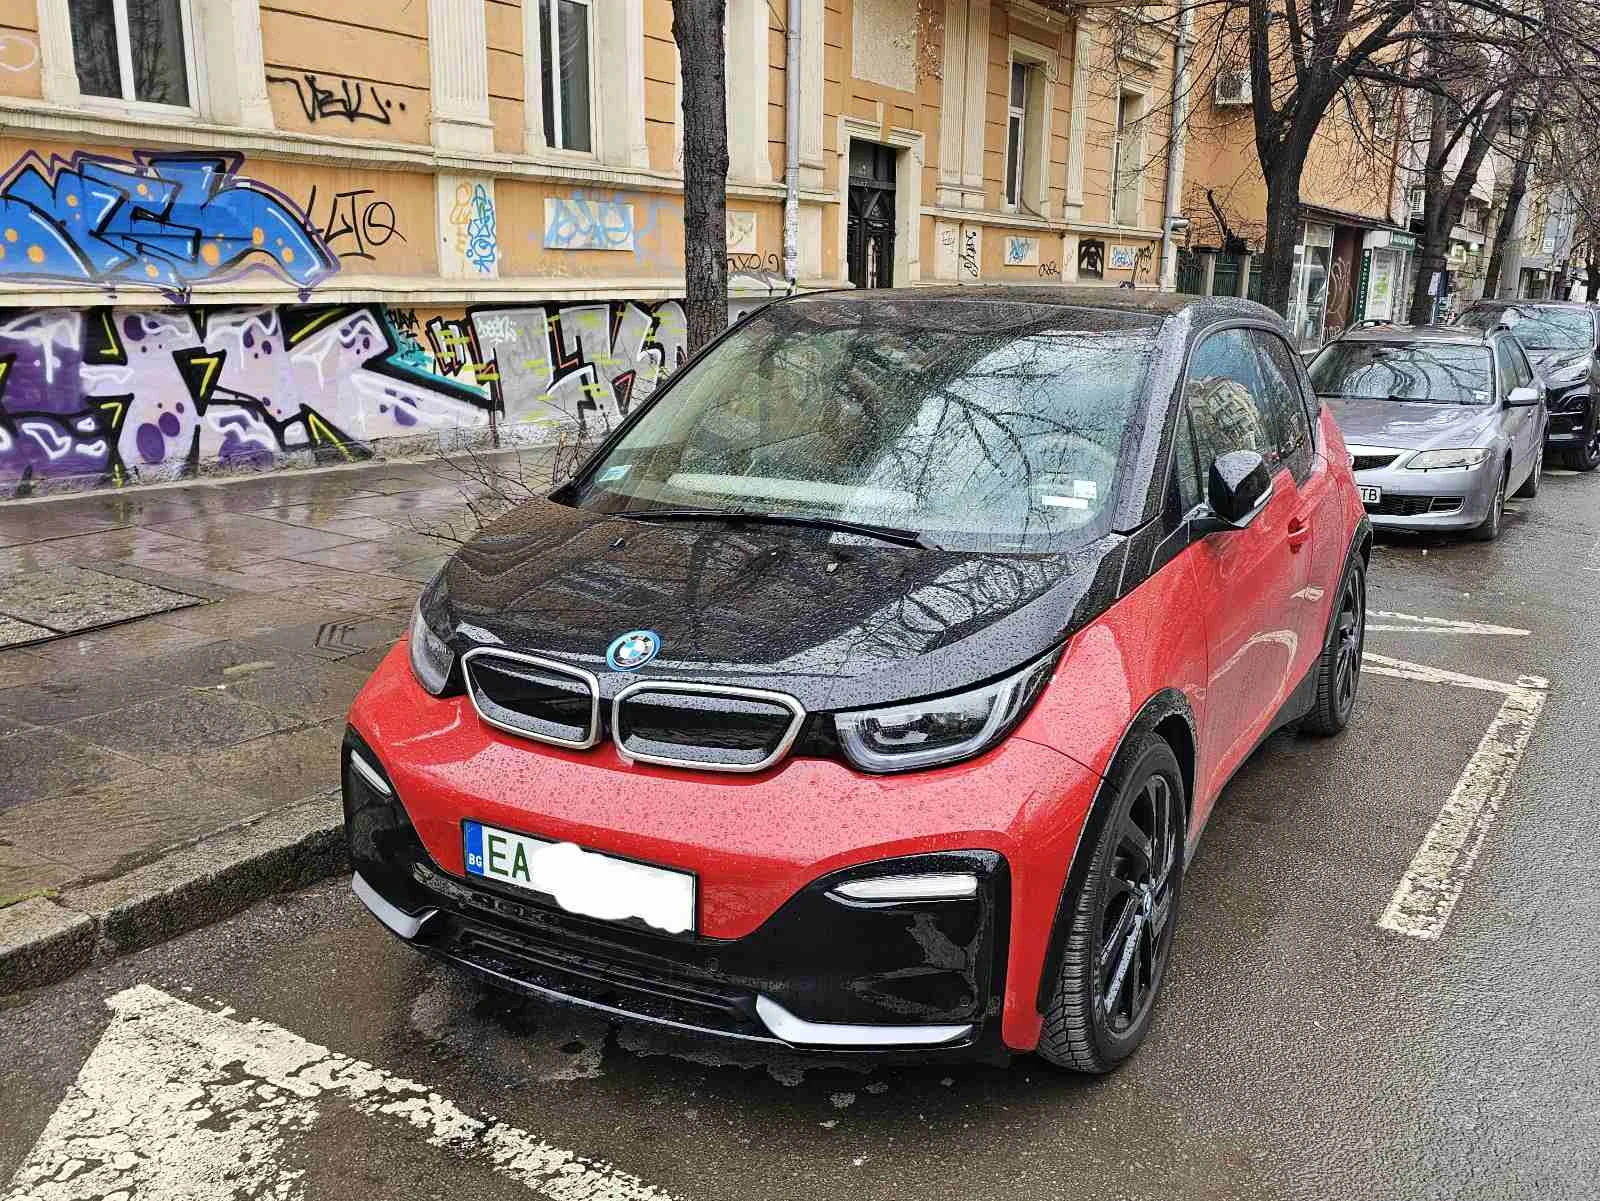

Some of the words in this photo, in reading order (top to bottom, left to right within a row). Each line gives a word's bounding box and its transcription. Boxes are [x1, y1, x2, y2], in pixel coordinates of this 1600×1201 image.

[1360, 487, 1378, 501] TB
[468, 852, 482, 868] BG
[488, 833, 531, 882] EA
